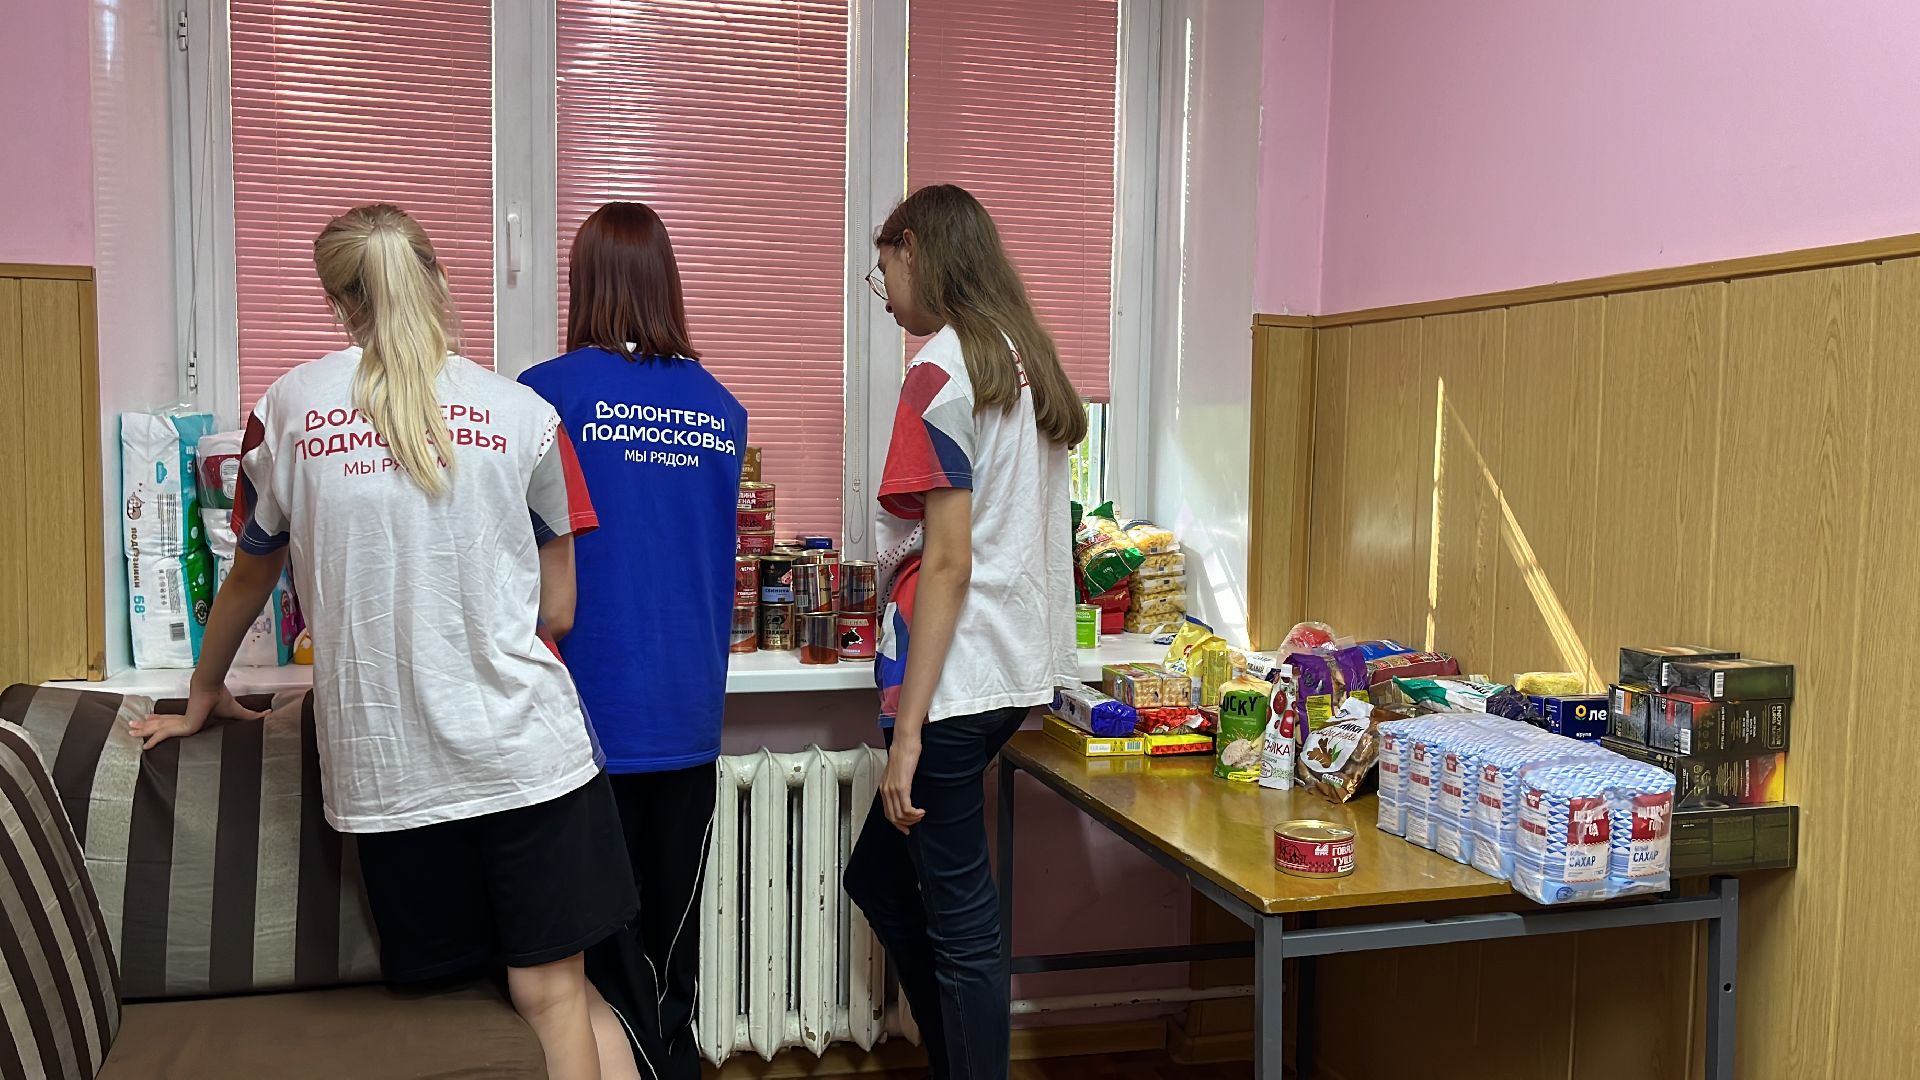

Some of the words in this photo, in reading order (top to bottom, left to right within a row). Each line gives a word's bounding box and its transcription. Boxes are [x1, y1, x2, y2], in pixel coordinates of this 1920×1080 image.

[305, 404, 490, 432] ВОЛРЫ
[595, 400, 726, 432] ВОЛОНТЕРЫ
[294, 428, 508, 463] ПОДМОВЬЯ
[582, 423, 736, 456] ПОДМОСКОВЬЯ
[344, 459, 376, 477] МЫ
[624, 450, 647, 463] МЫ
[650, 452, 699, 467] РЯДОМ
[134, 595, 145, 614] 58
[1569, 855, 1597, 868] САХАР
[1632, 850, 1660, 863] САХАР
